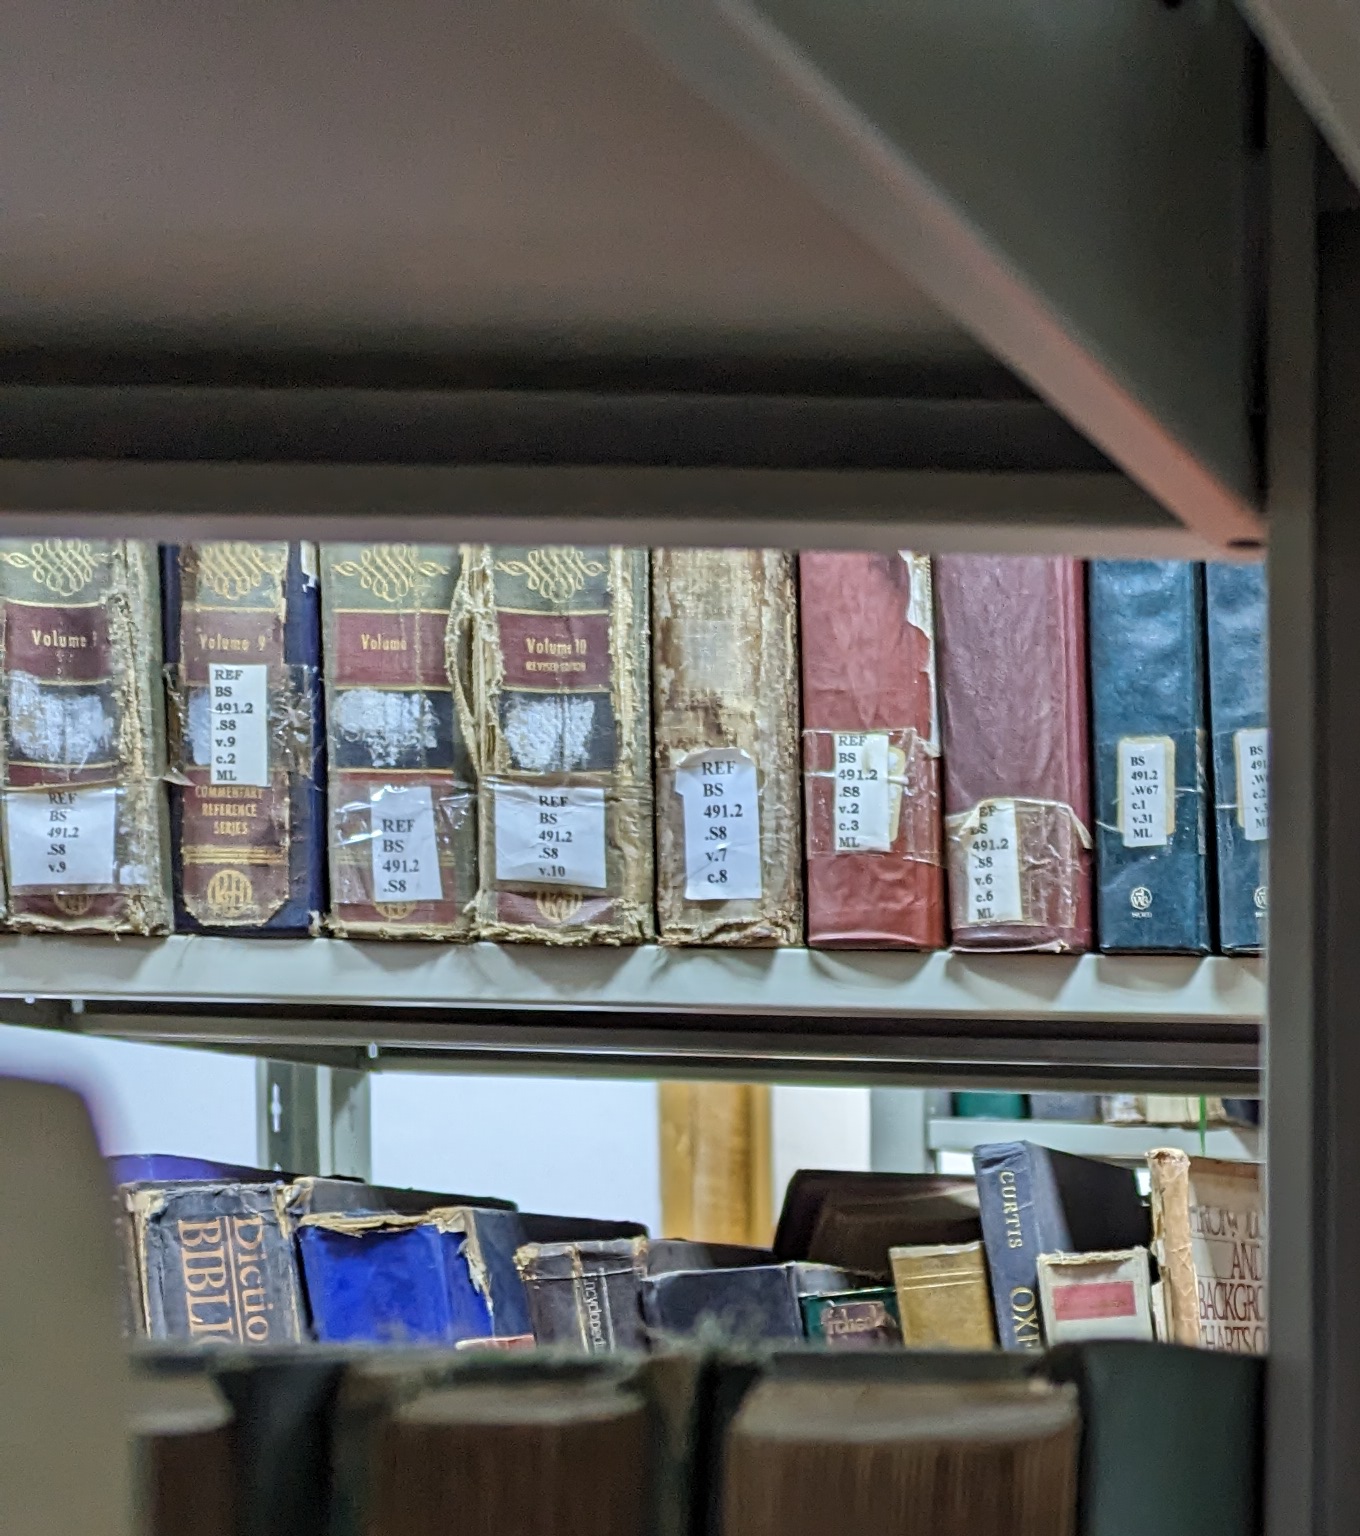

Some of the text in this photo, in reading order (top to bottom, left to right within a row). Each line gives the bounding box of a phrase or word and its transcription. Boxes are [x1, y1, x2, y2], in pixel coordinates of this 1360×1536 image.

[575, 639, 587, 654] 10
[214, 670, 243, 680] REF
[215, 687, 232, 697] BS
[215, 703, 253, 713] 491.2
[216, 720, 236, 730] .S8
[216, 737, 235, 747] v.9
[216, 754, 235, 764] c.2
[1131, 757, 1145, 766] BS
[702, 761, 736, 775] REF
[217, 771, 237, 781] ML
[1131, 771, 1158, 780] 491.2
[703, 783, 723, 796] BS
[1131, 785, 1158, 795] .W67
[539, 796, 568, 806] REF
[1132, 800, 1146, 809] c.1
[202, 804, 257, 816] REFERENCE
[704, 804, 742, 818] 491.2
[539, 813, 558, 824] BS
[1133, 814, 1153, 823] v.31
[214, 822, 248, 835] SERIES
[705, 826, 727, 840] .S8
[1134, 829, 1152, 838] ML
[539, 832, 572, 842] 491.2
[539, 848, 558, 859] .S8
[706, 849, 726, 861] v.7
[539, 866, 565, 877] v.10
[707, 869, 727, 883] c.8
[1000, 1172, 1022, 1248] CURTIS
